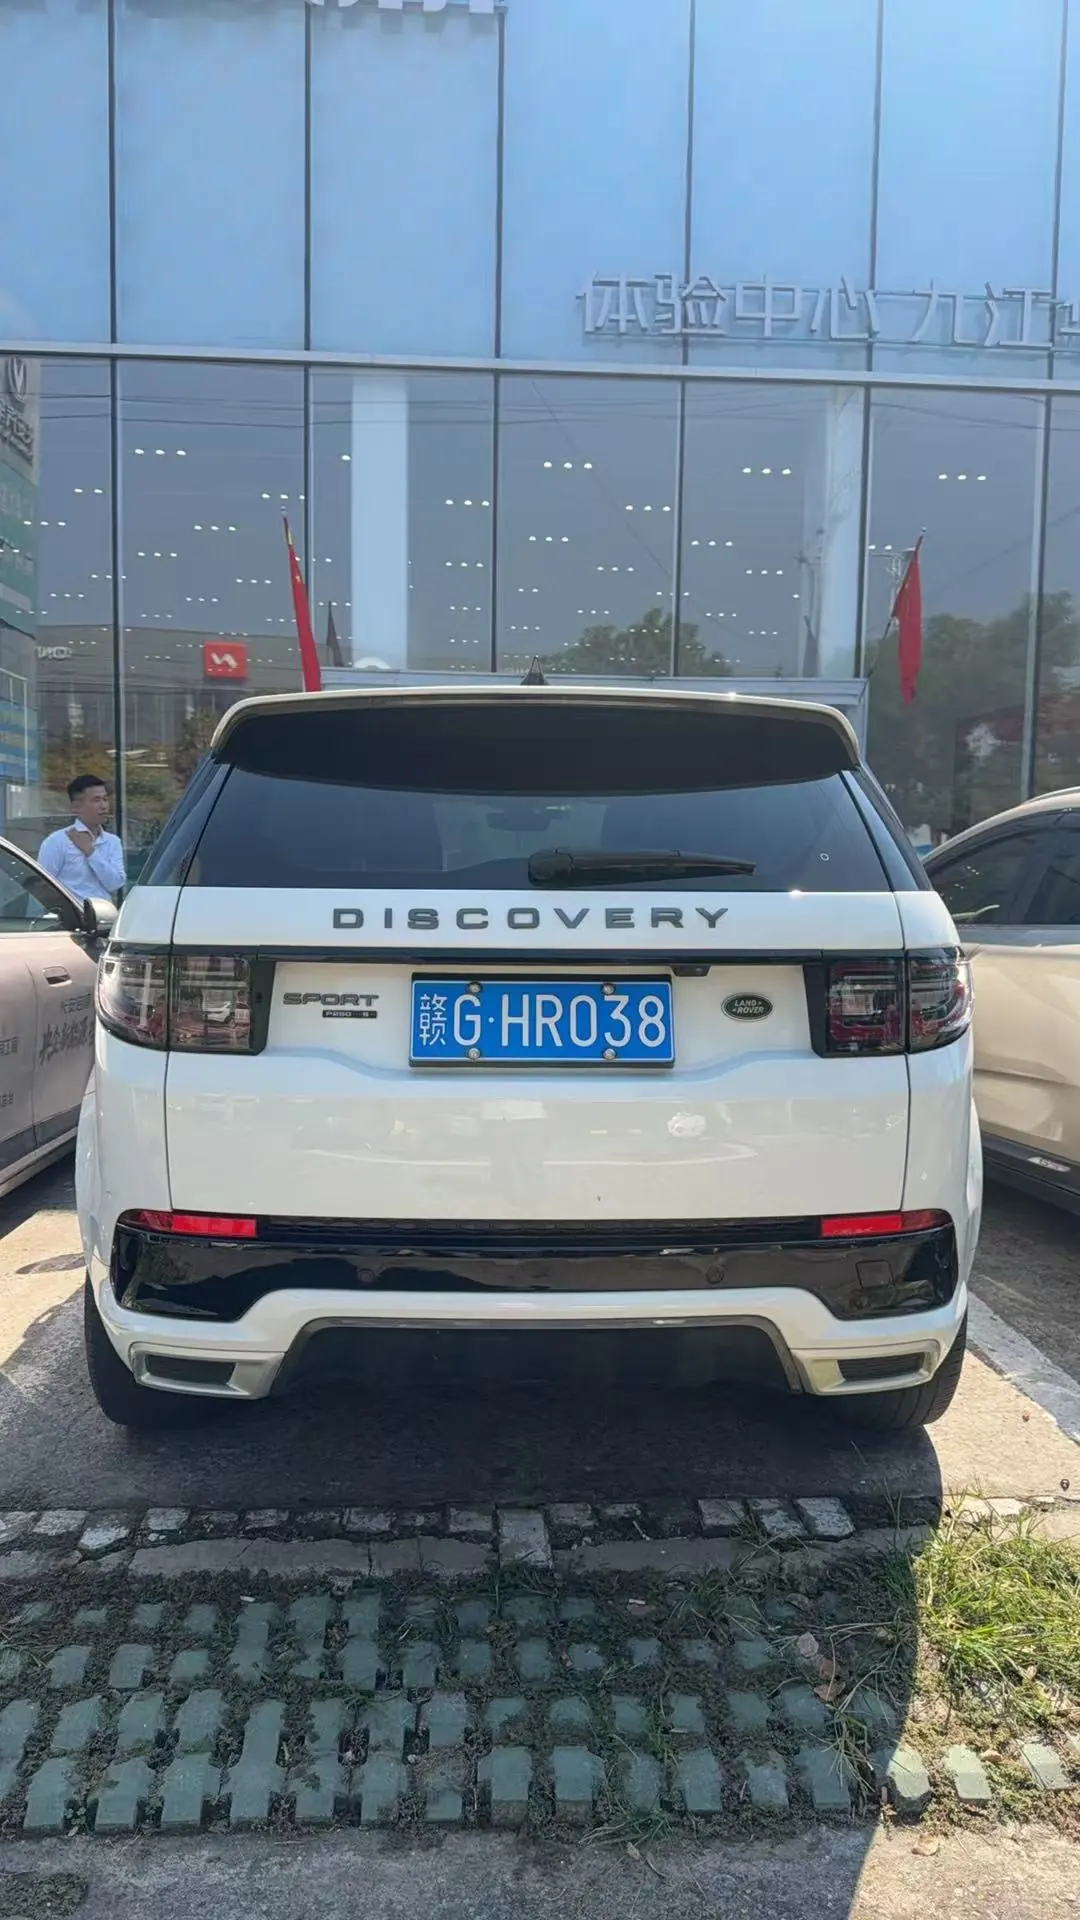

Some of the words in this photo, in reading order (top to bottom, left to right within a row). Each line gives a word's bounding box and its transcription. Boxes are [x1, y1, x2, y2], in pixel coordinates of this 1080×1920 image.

[576, 272, 882, 341] 体验中心
[332, 907, 729, 930] DISCOVERY
[283, 992, 379, 1007] SPORT
[734, 999, 757, 1007] LAND
[736, 1006, 765, 1014] ROVER
